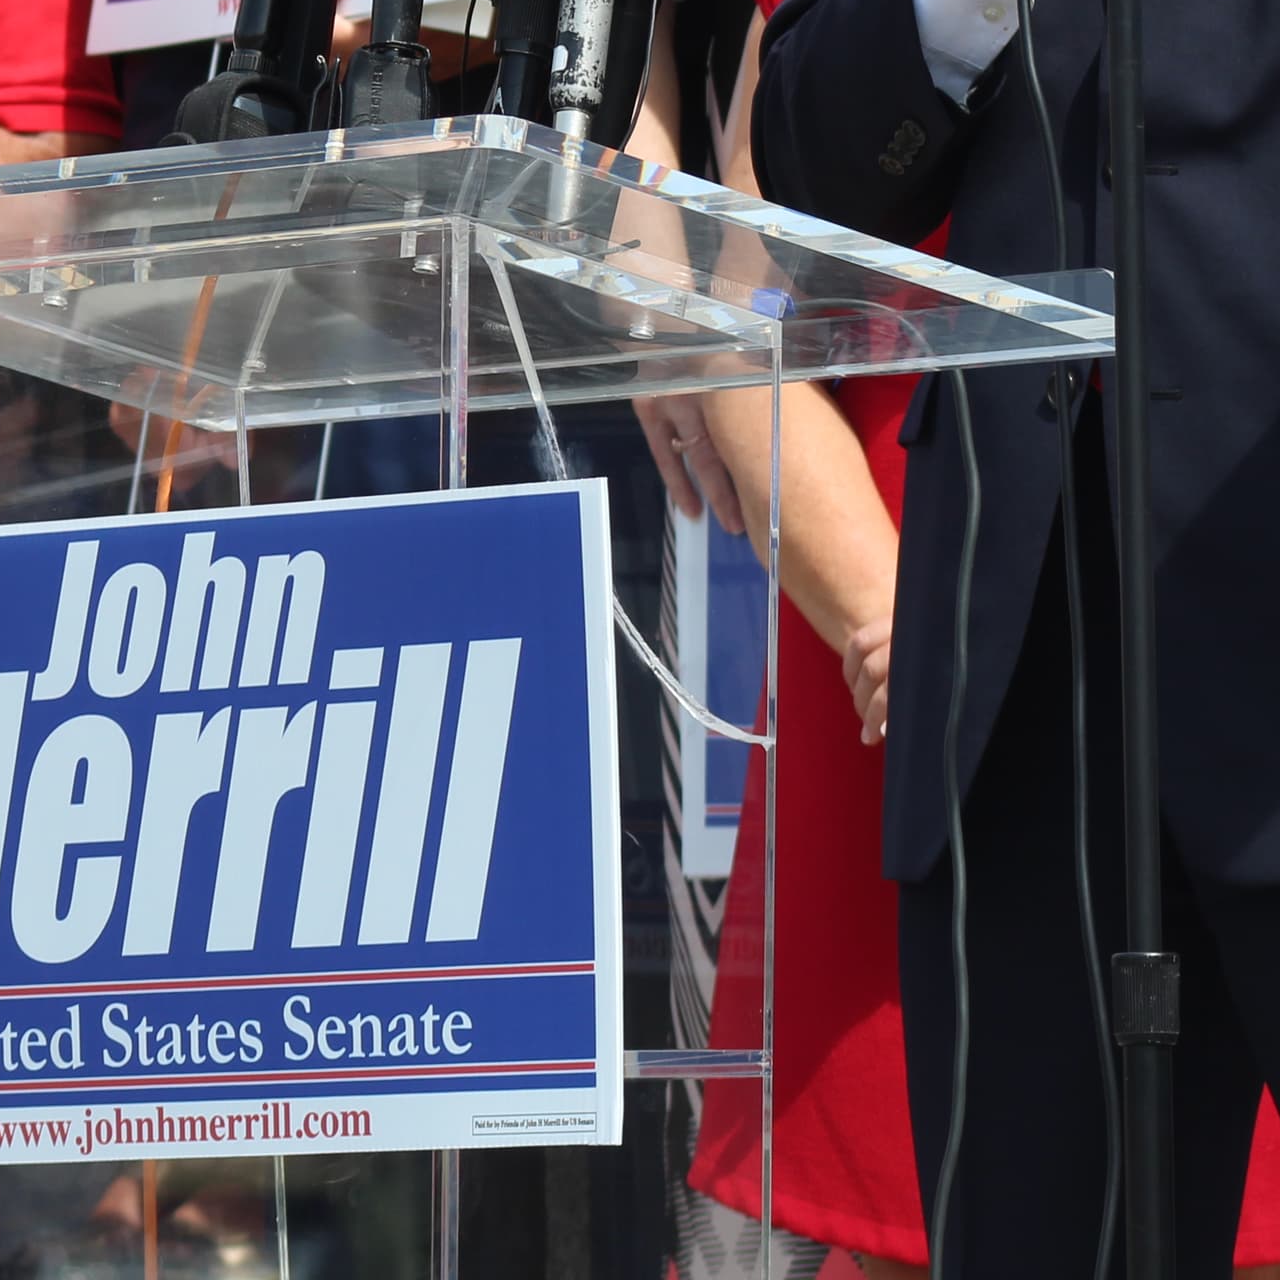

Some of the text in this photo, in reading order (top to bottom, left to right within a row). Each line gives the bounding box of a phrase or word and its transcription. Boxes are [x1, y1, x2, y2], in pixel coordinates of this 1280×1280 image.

[31, 530, 326, 702] John
[101, 1002, 264, 1068] States
[282, 995, 473, 1060] Senate
